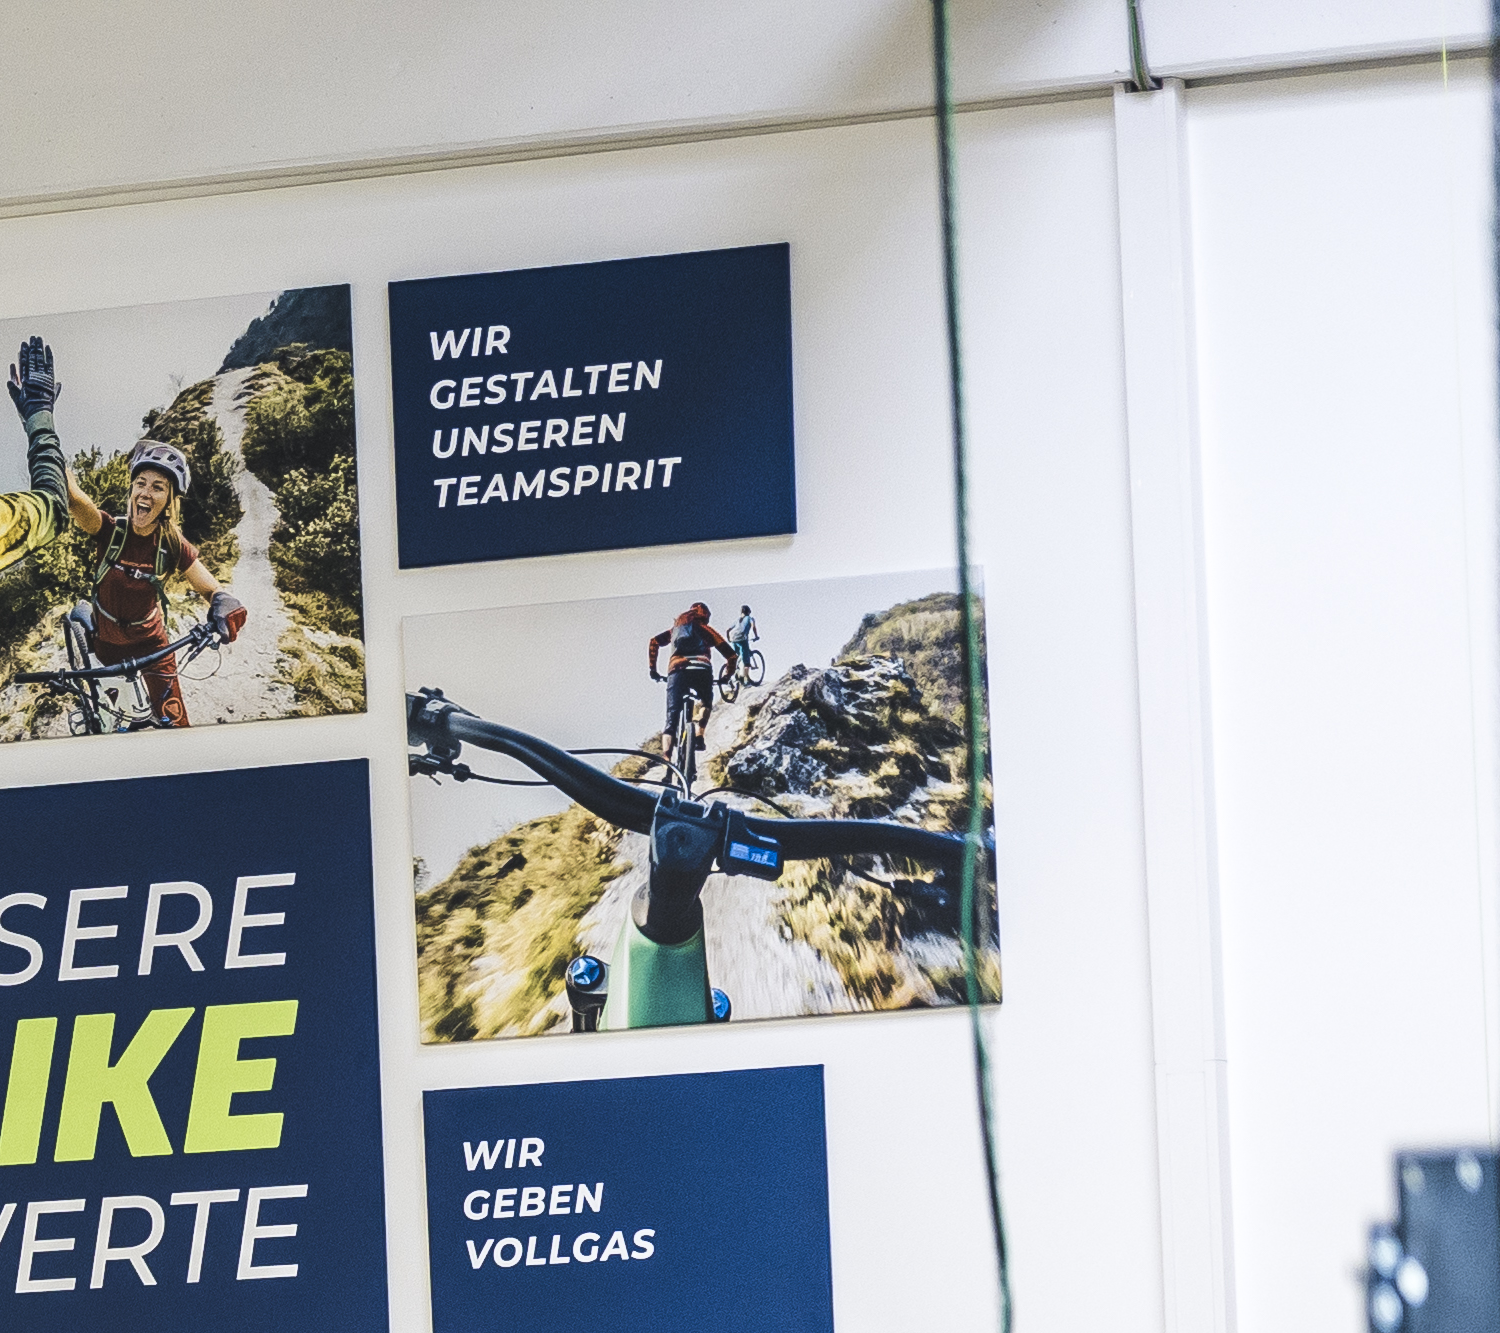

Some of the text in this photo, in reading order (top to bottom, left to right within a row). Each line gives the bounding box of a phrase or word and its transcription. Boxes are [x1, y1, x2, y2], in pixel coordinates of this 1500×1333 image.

[429, 324, 511, 361] WIR
[430, 359, 663, 410] GESTALTEN
[432, 412, 627, 459] UNSEREN
[433, 456, 682, 508] TEAMSPIRIT
[462, 1137, 545, 1171] WIR
[463, 1182, 604, 1221] GEBEN
[465, 1228, 656, 1270] VOLLGAS
